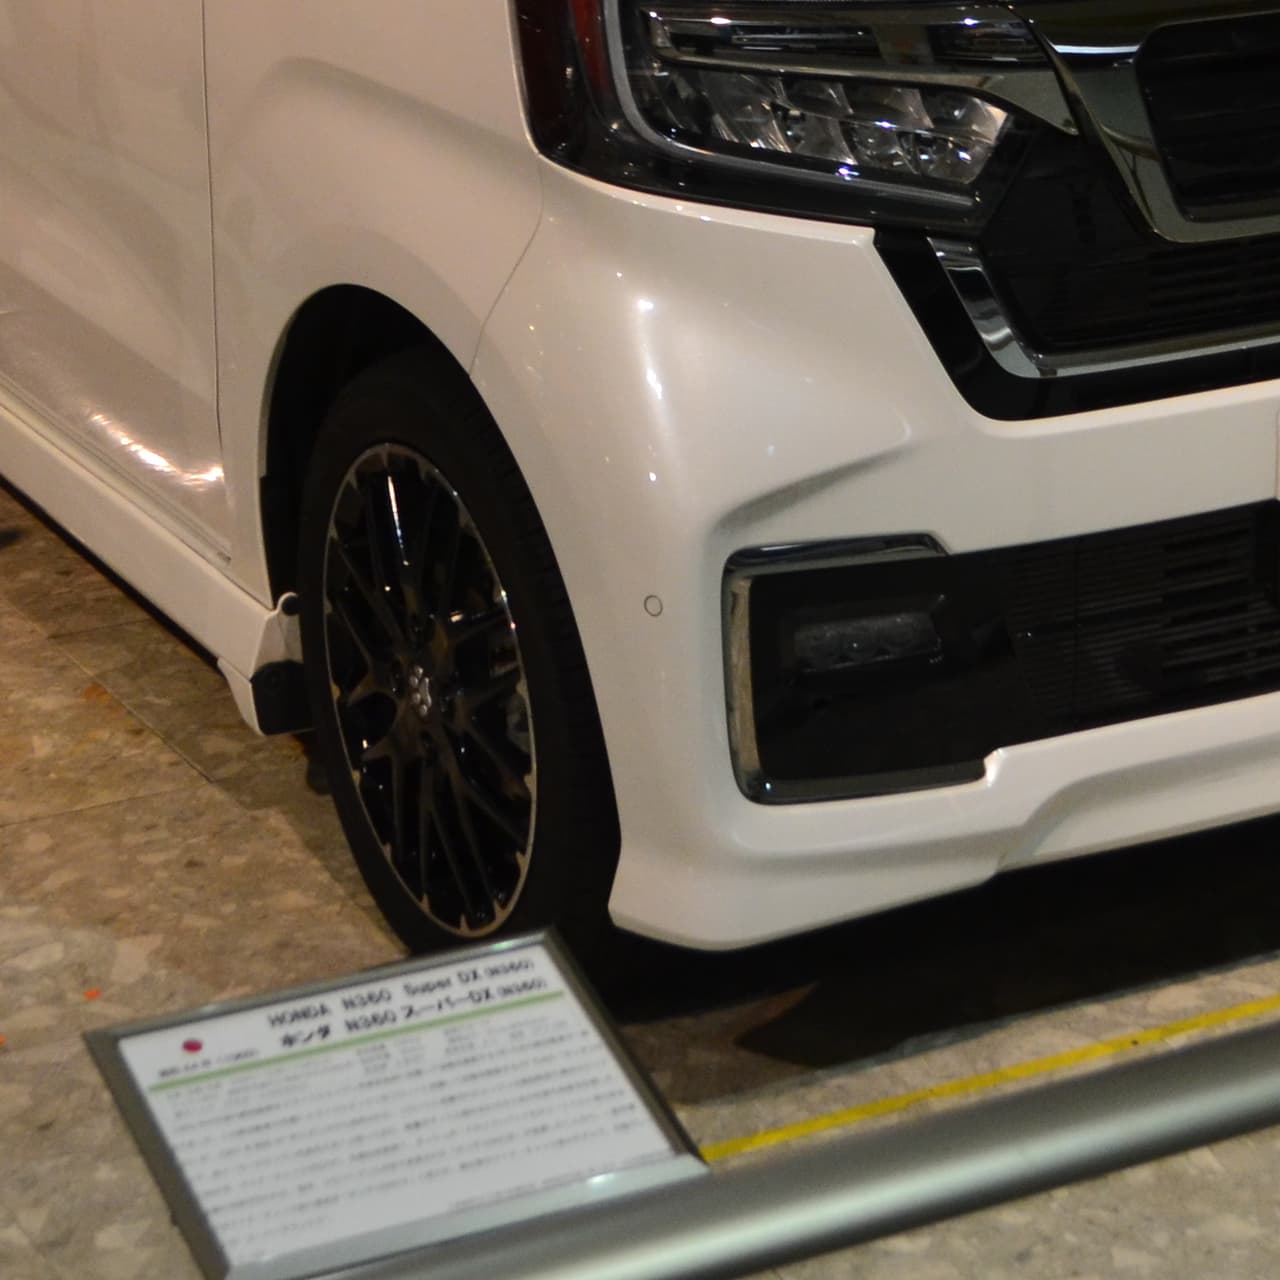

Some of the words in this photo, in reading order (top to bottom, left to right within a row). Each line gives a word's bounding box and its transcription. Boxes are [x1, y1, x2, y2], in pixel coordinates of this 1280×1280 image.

[269, 1004, 330, 1028] HONDA
[342, 989, 392, 1011] N360
[403, 977, 453, 997] Super
